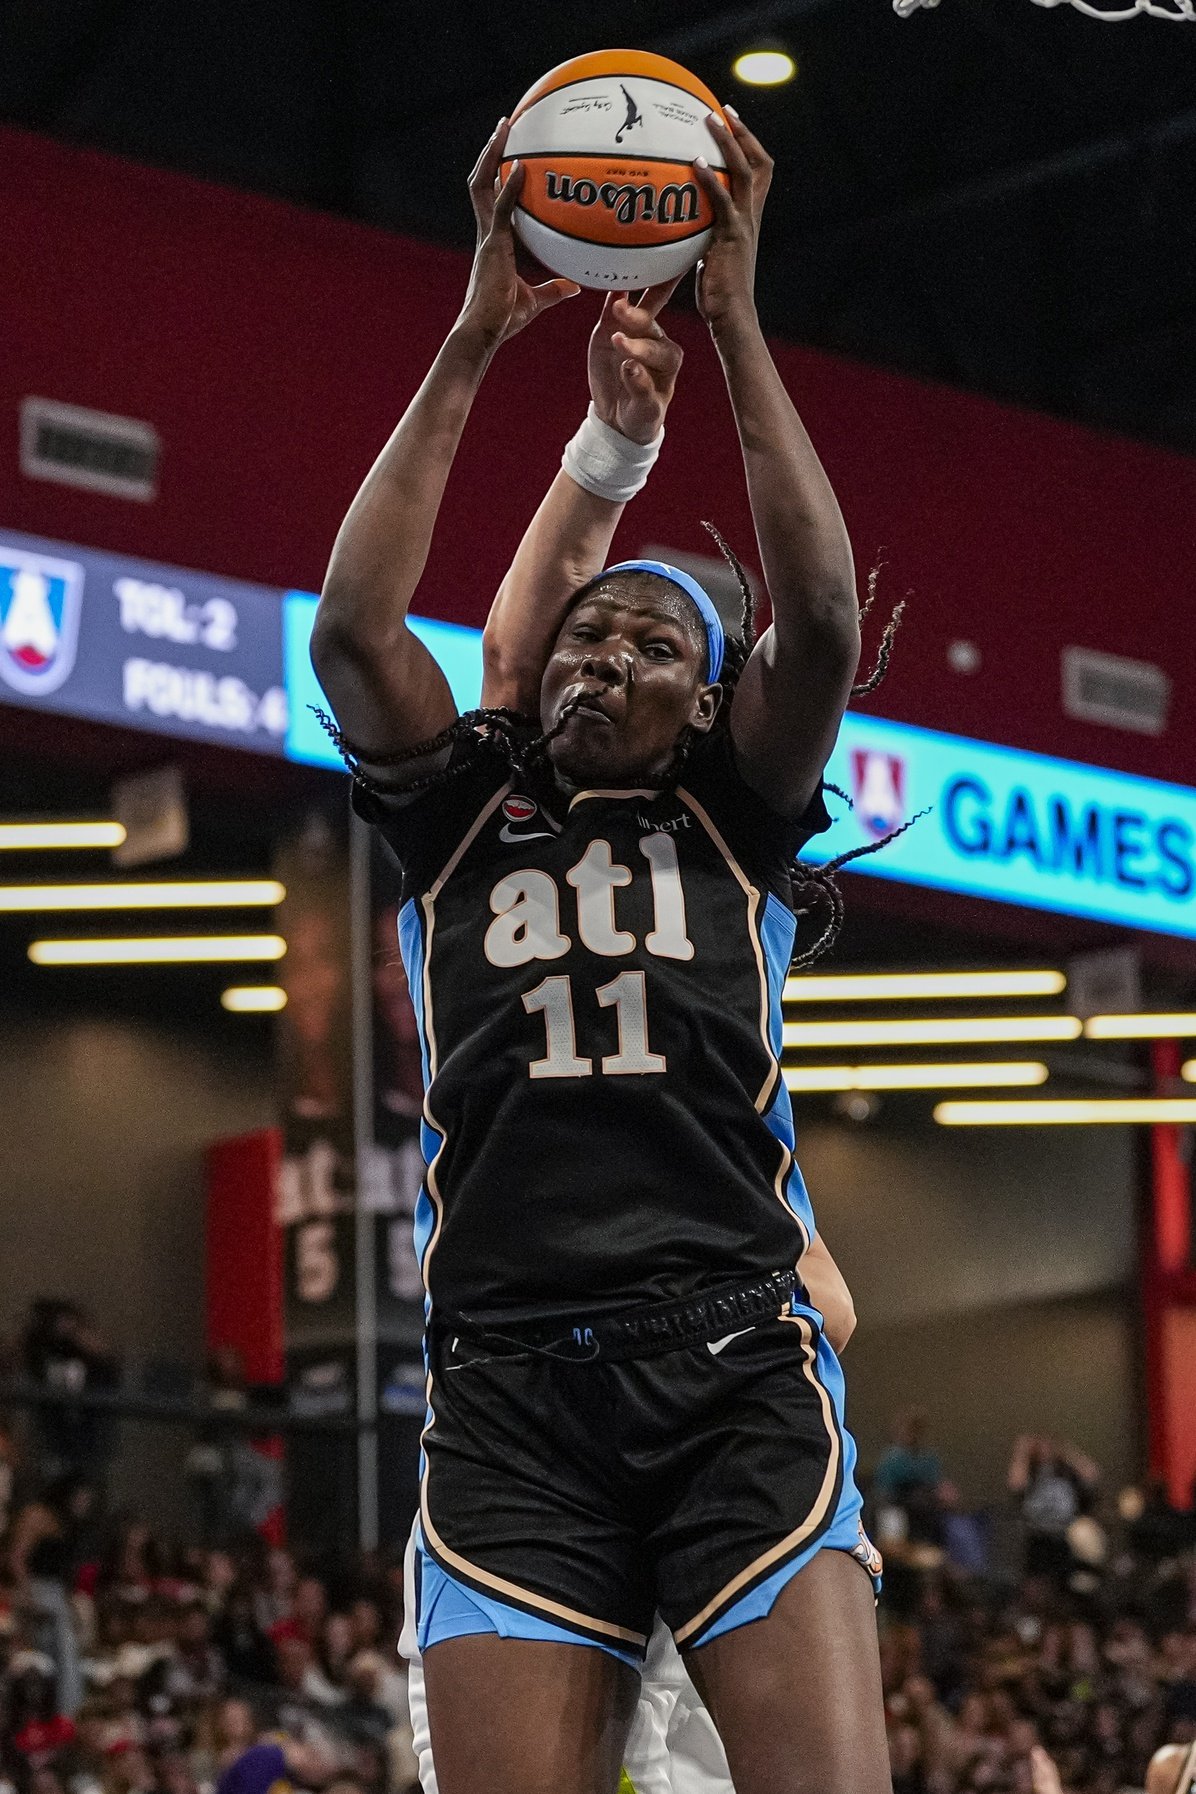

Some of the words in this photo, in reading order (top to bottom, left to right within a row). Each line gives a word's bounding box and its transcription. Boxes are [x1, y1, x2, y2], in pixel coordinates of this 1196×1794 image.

[545, 171, 699, 225] Wilson
[942, 771, 1195, 904] GAMES
[484, 832, 695, 968] atl
[520, 970, 667, 1079] 11
